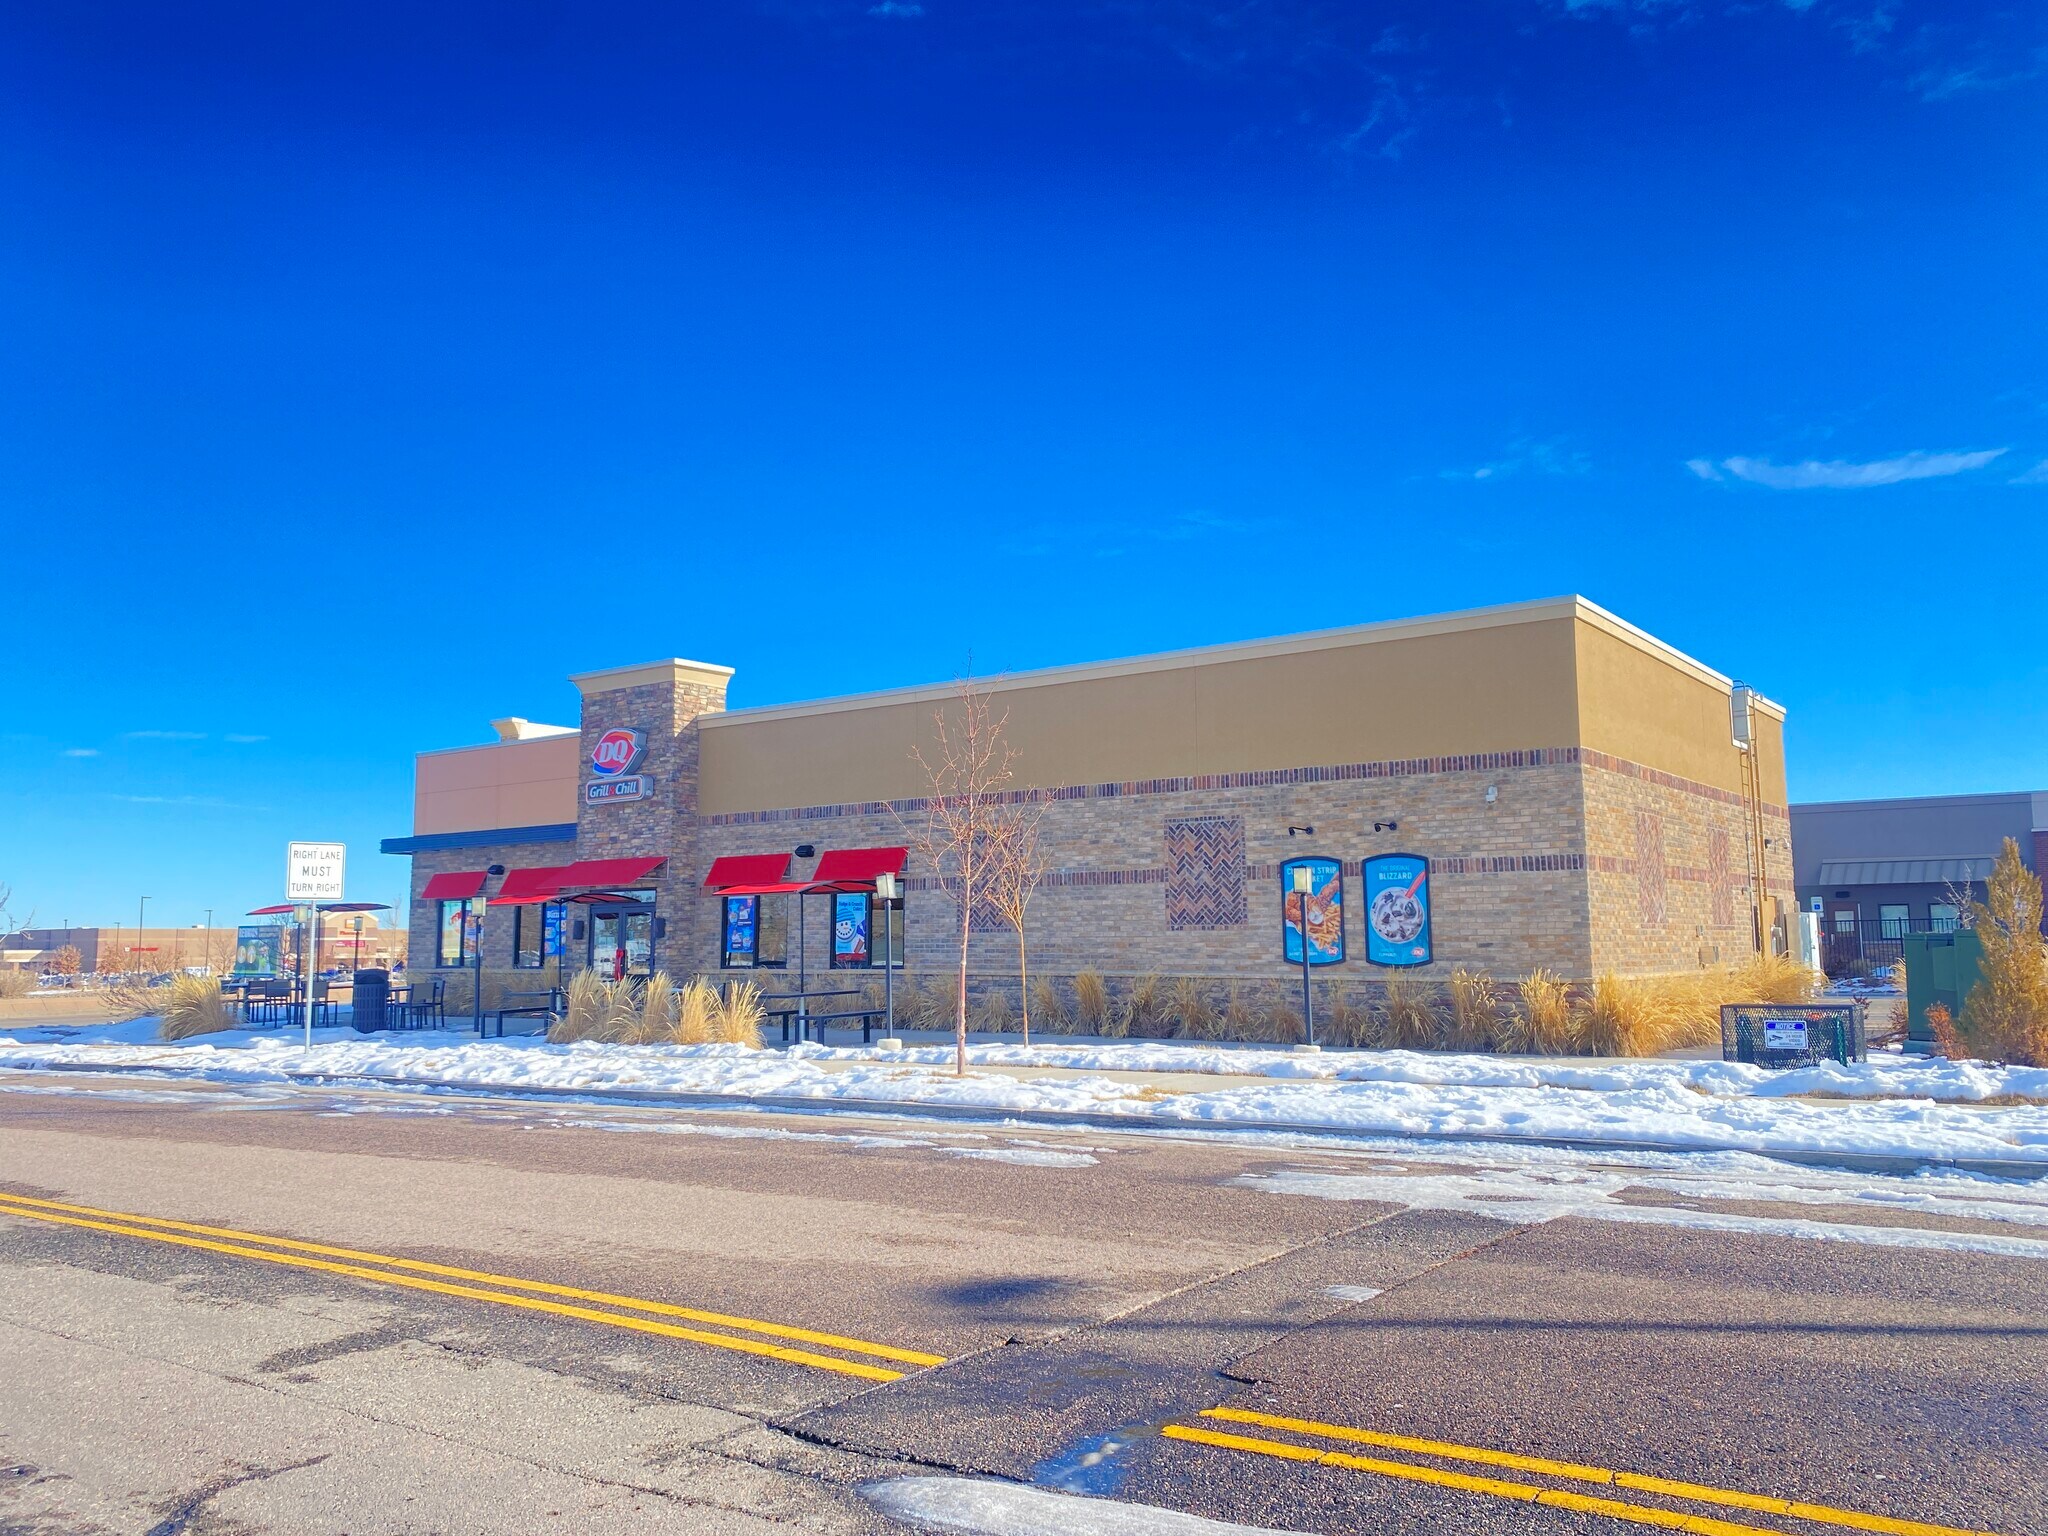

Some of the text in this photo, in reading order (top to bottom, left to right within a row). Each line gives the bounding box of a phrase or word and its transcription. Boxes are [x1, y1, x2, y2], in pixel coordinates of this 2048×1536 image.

[599, 740, 628, 763] DQ
[590, 785, 609, 798] Grill
[616, 781, 637, 793] Chill
[293, 850, 341, 860] RIGHT LANE
[302, 865, 331, 877] MUST
[1317, 866, 1337, 874] STRIP
[1378, 872, 1412, 880] BLIZZARD
[291, 882, 340, 892] TURN RIGHT
